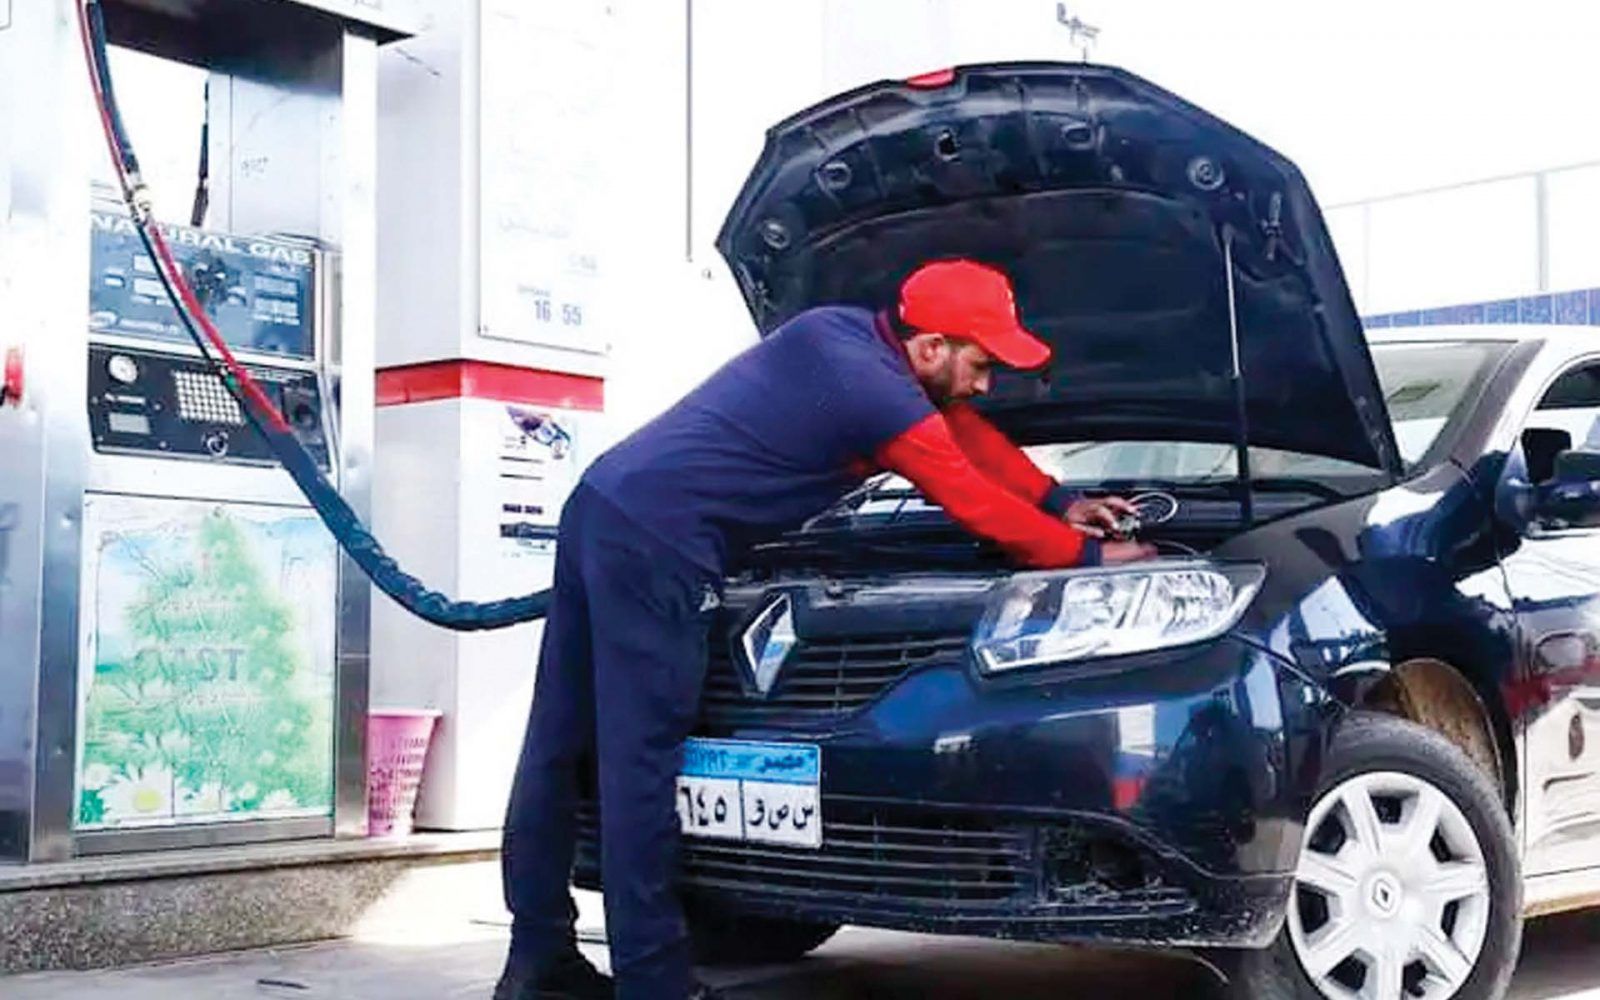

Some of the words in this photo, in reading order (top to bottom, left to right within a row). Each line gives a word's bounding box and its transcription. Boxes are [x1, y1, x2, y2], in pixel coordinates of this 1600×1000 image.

[91, 213, 243, 255] NAURAL
[249, 241, 311, 266] GAS
[533, 299, 552, 323] 16
[561, 303, 582, 326] 55
